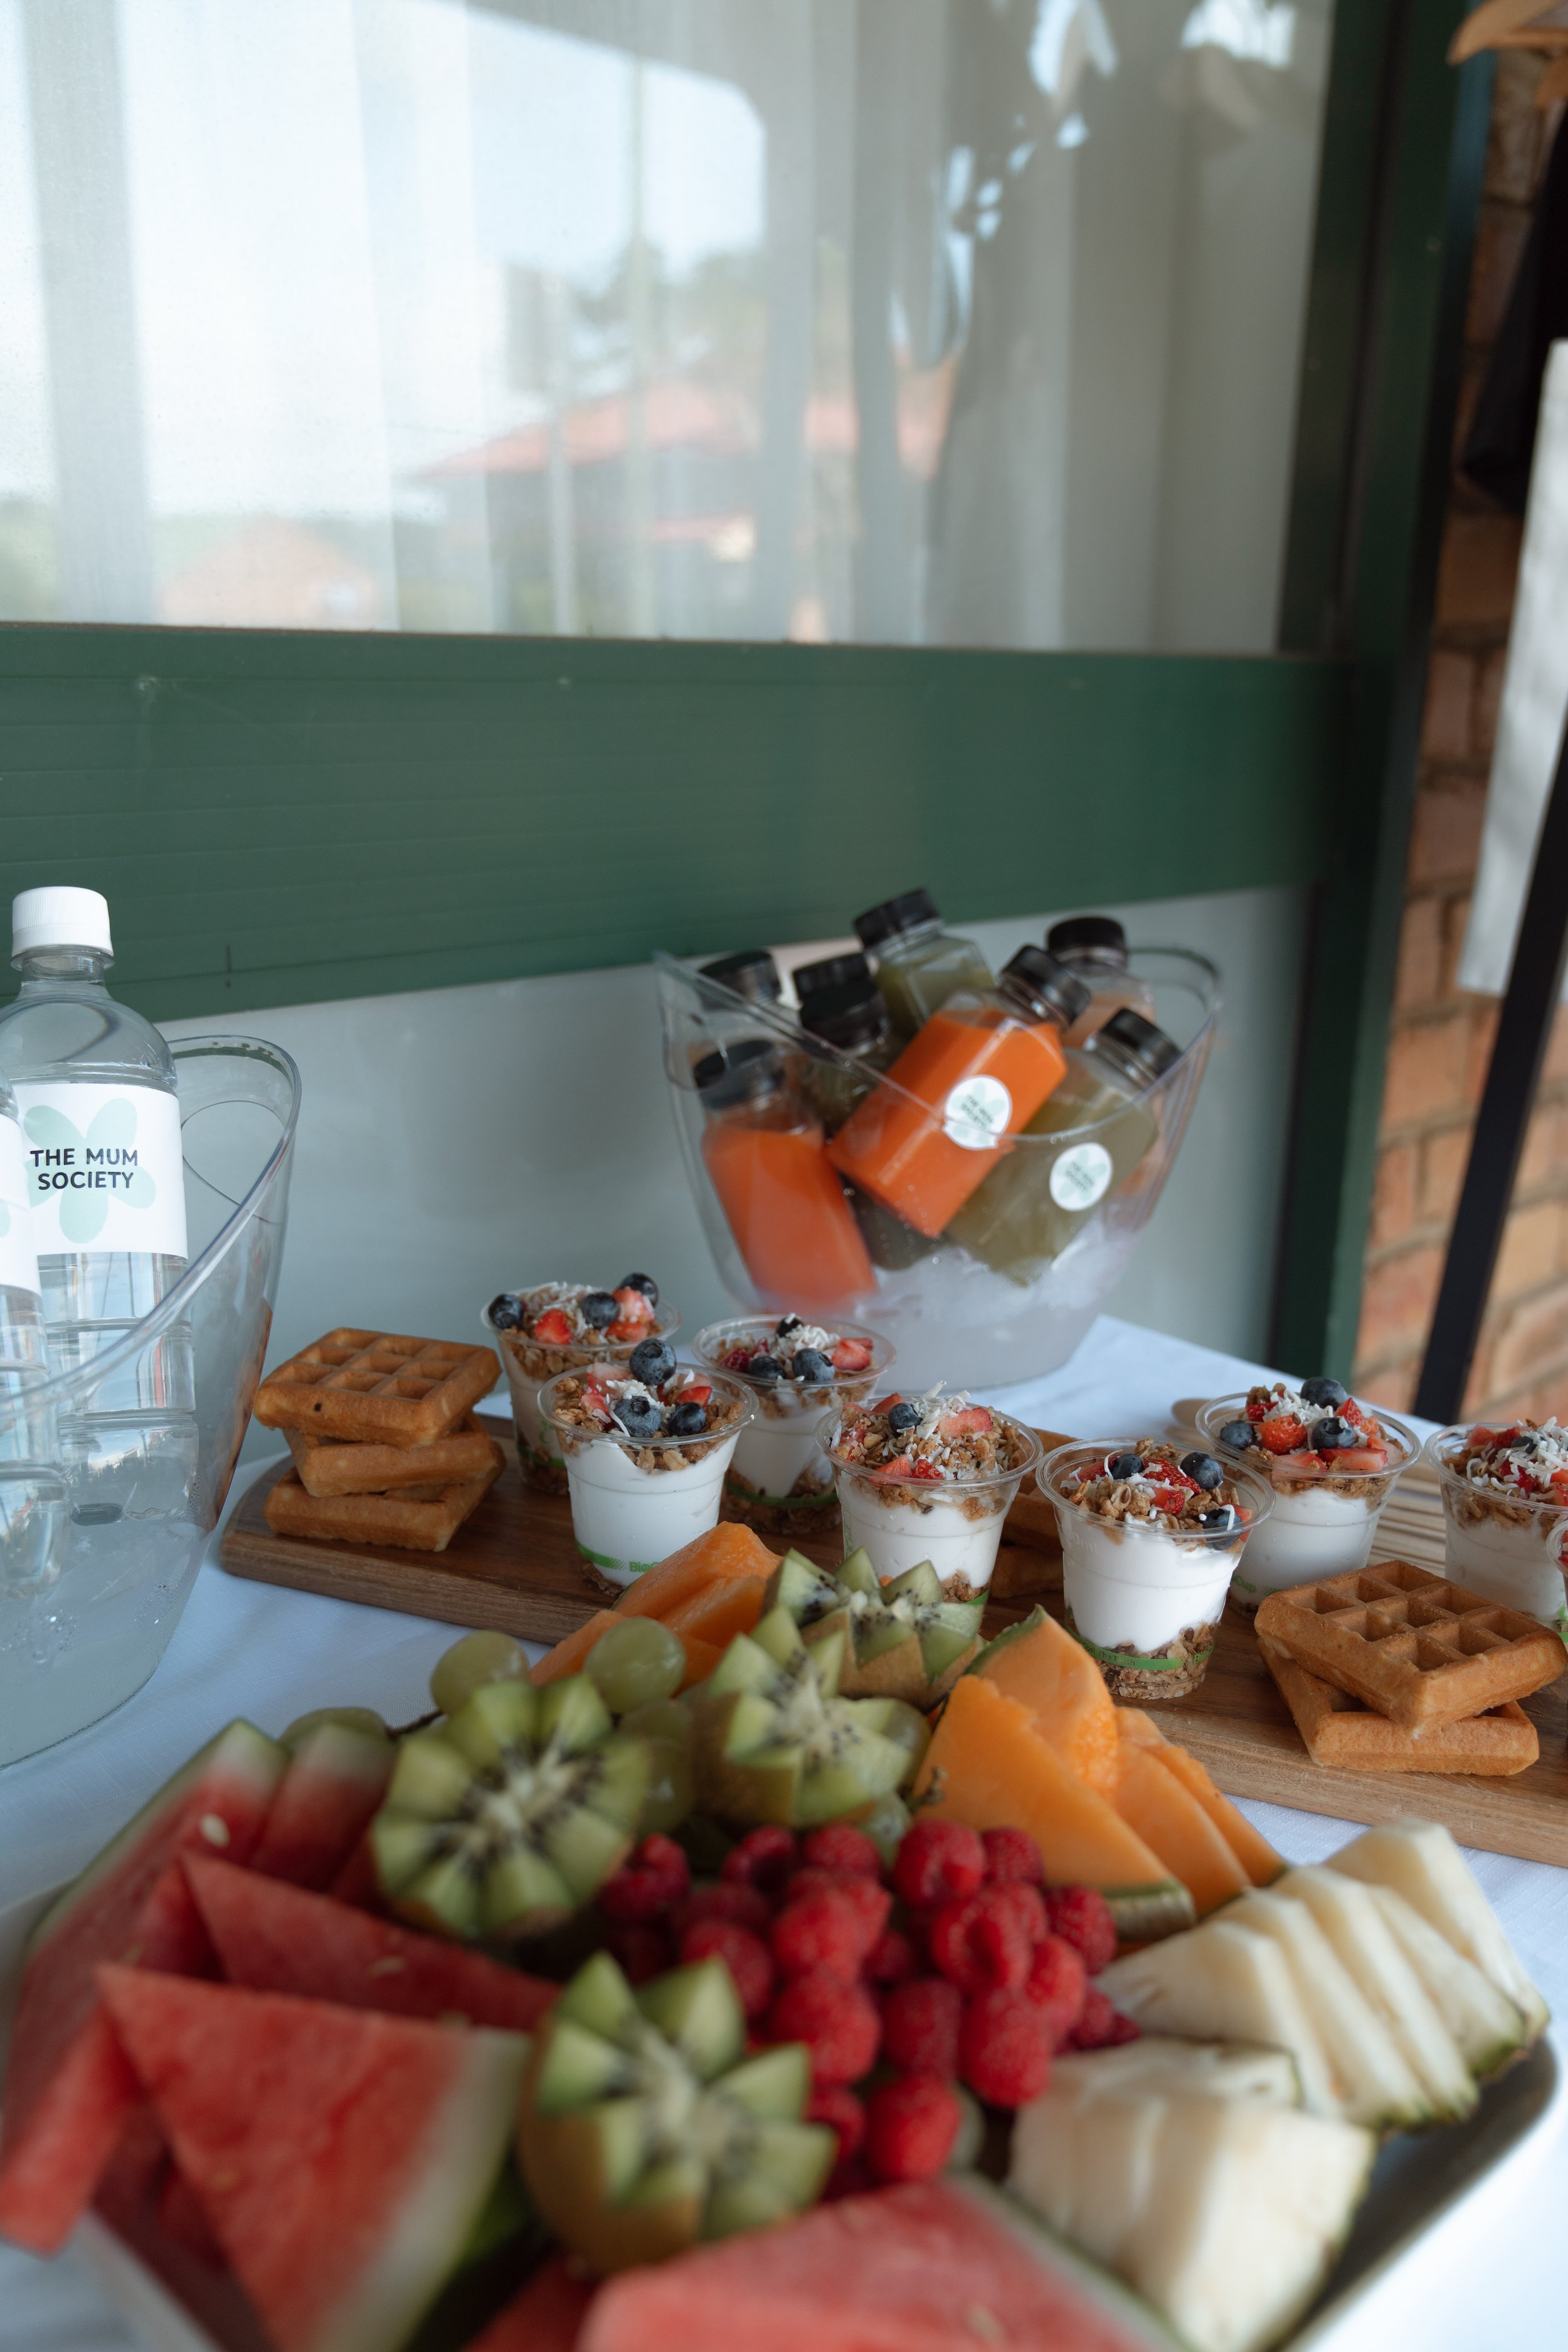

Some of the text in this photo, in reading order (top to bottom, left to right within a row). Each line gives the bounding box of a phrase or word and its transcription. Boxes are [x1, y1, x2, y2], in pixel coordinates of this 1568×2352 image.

[30, 1148, 138, 1167] THE MUM
[38, 1171, 134, 1190] SOCIETY
[1232, 1575, 1256, 1593] Cup
